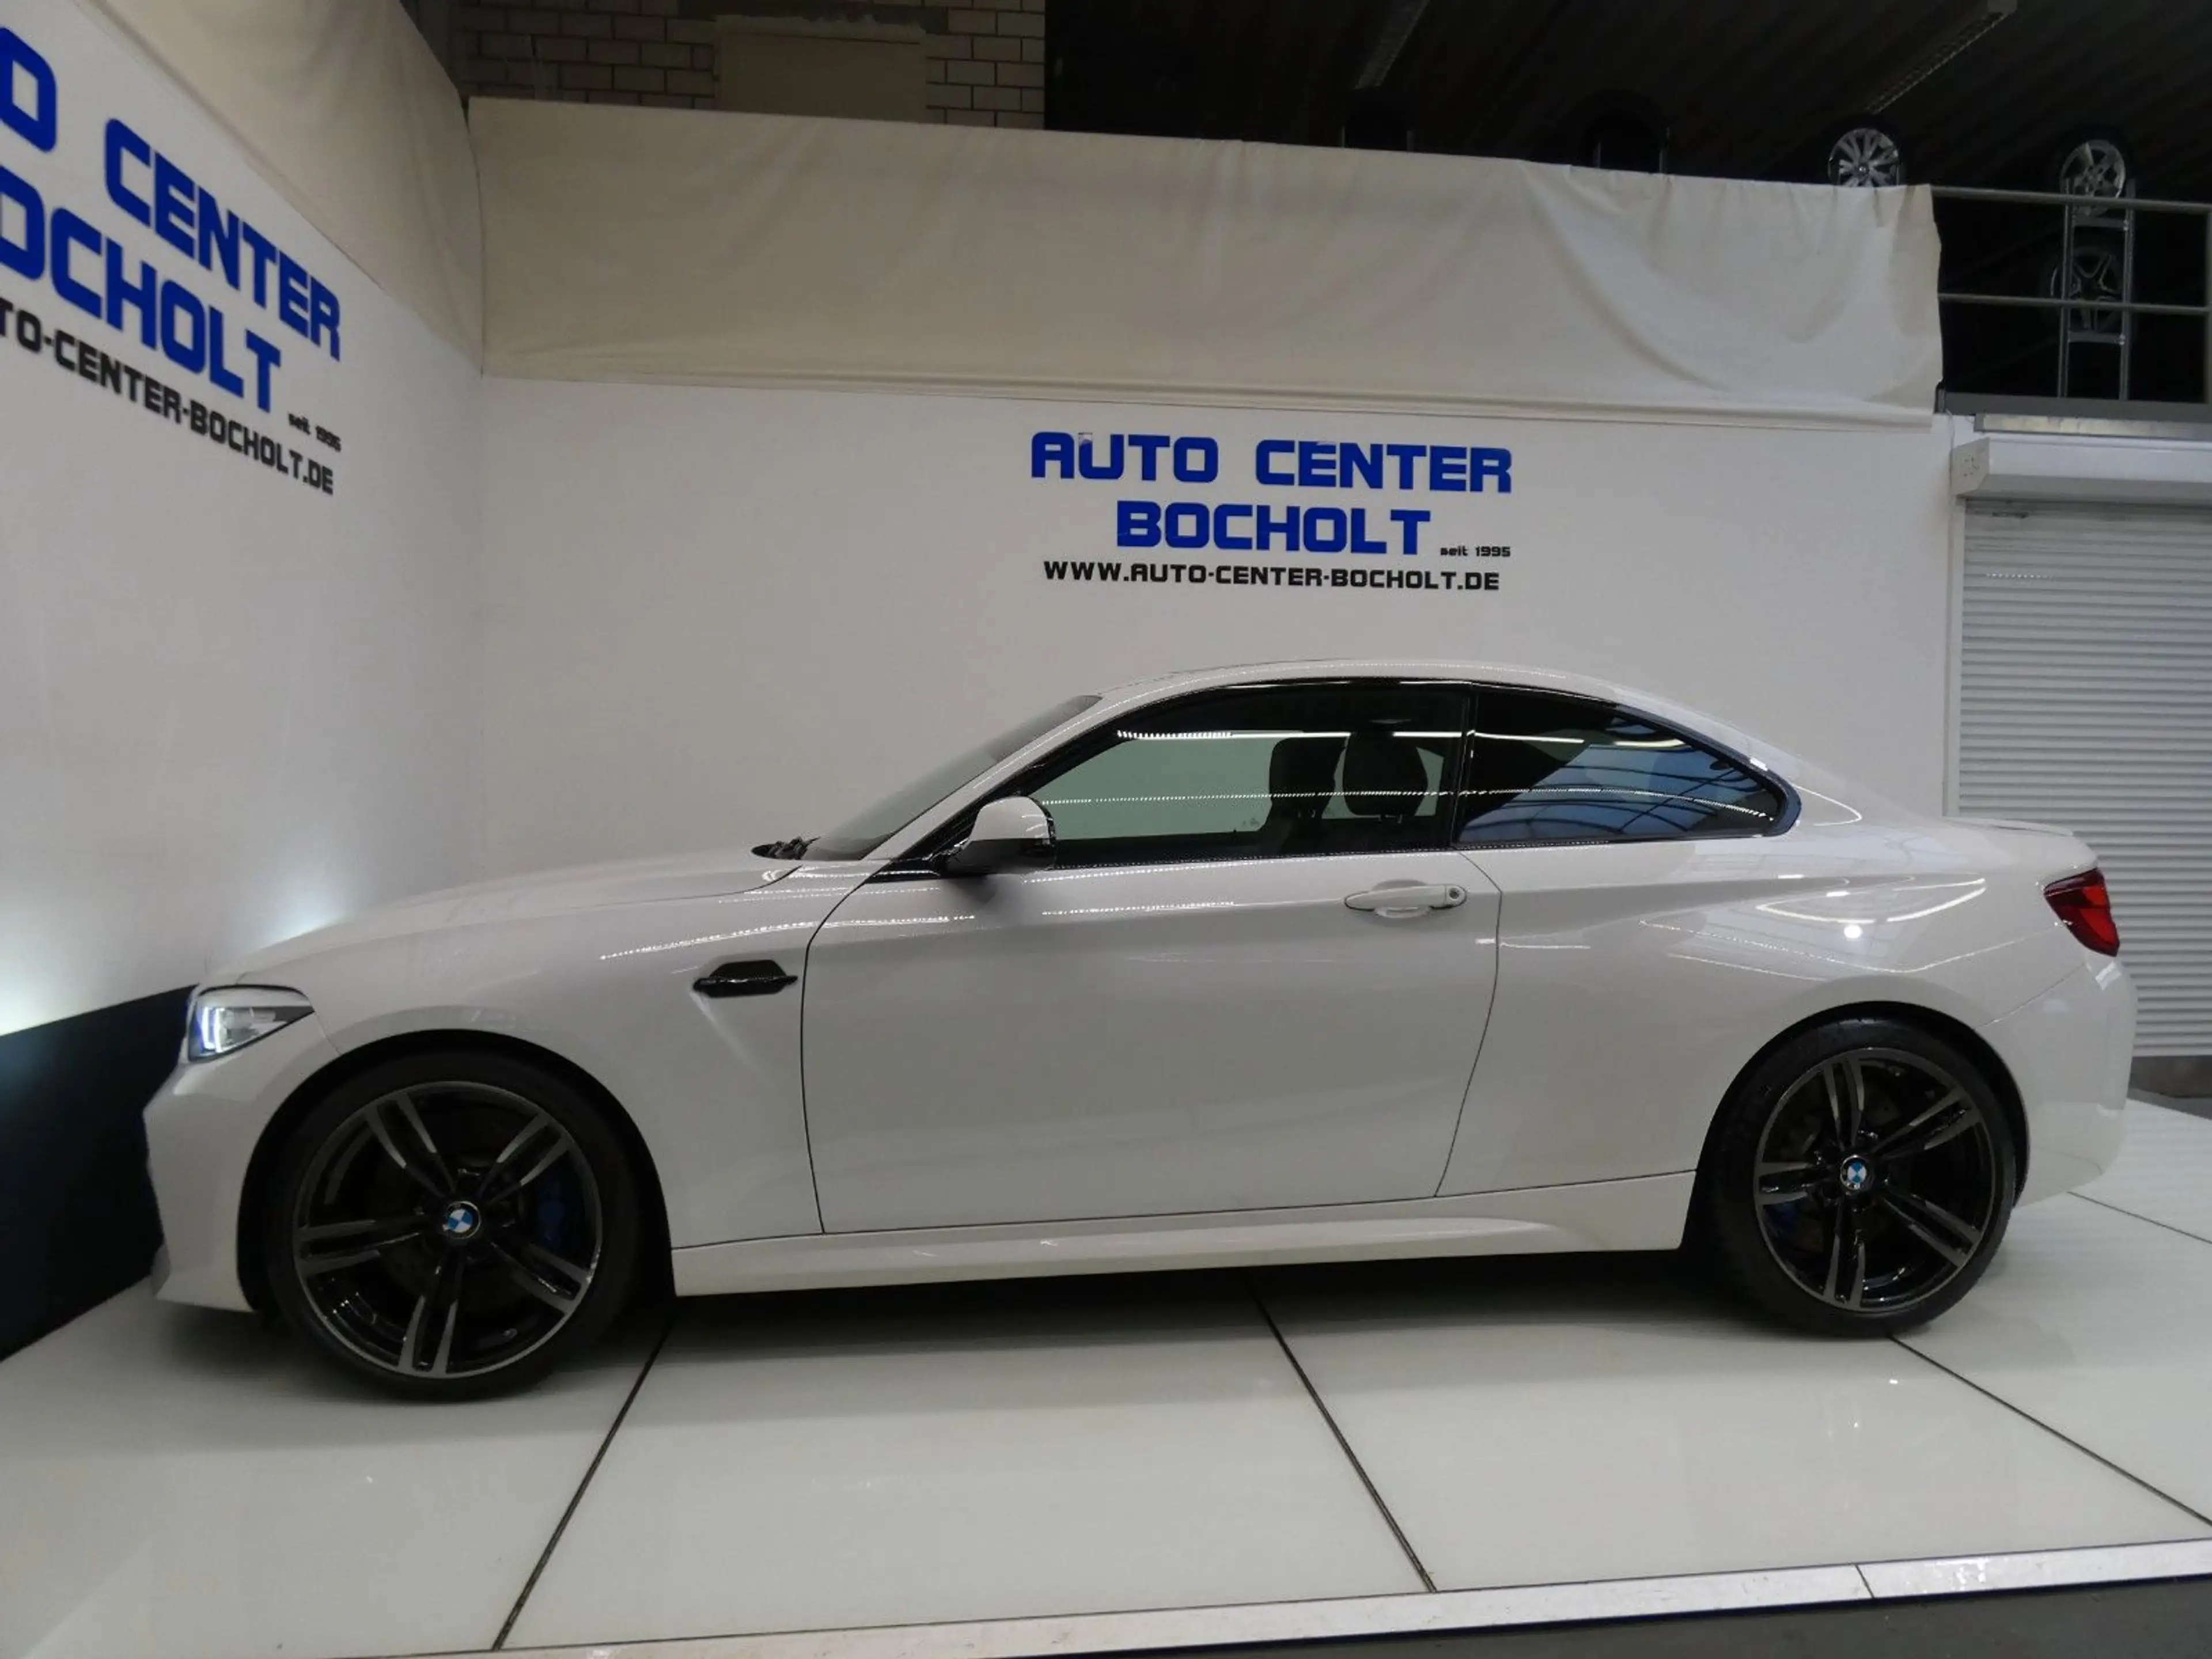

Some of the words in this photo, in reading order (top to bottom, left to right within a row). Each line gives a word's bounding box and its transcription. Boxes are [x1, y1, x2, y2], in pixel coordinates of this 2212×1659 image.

[105, 119, 340, 361] CENTER
[1031, 431, 1219, 483] AUTO
[1255, 439, 1512, 494] CENTER
[1116, 500, 1431, 555] BOCHOLT
[1440, 546, 1468, 556] seit
[1475, 546, 1511, 558] 1995
[1043, 560, 1499, 590] WWW.AUTO-CENTER-BOCHOLT.DE
